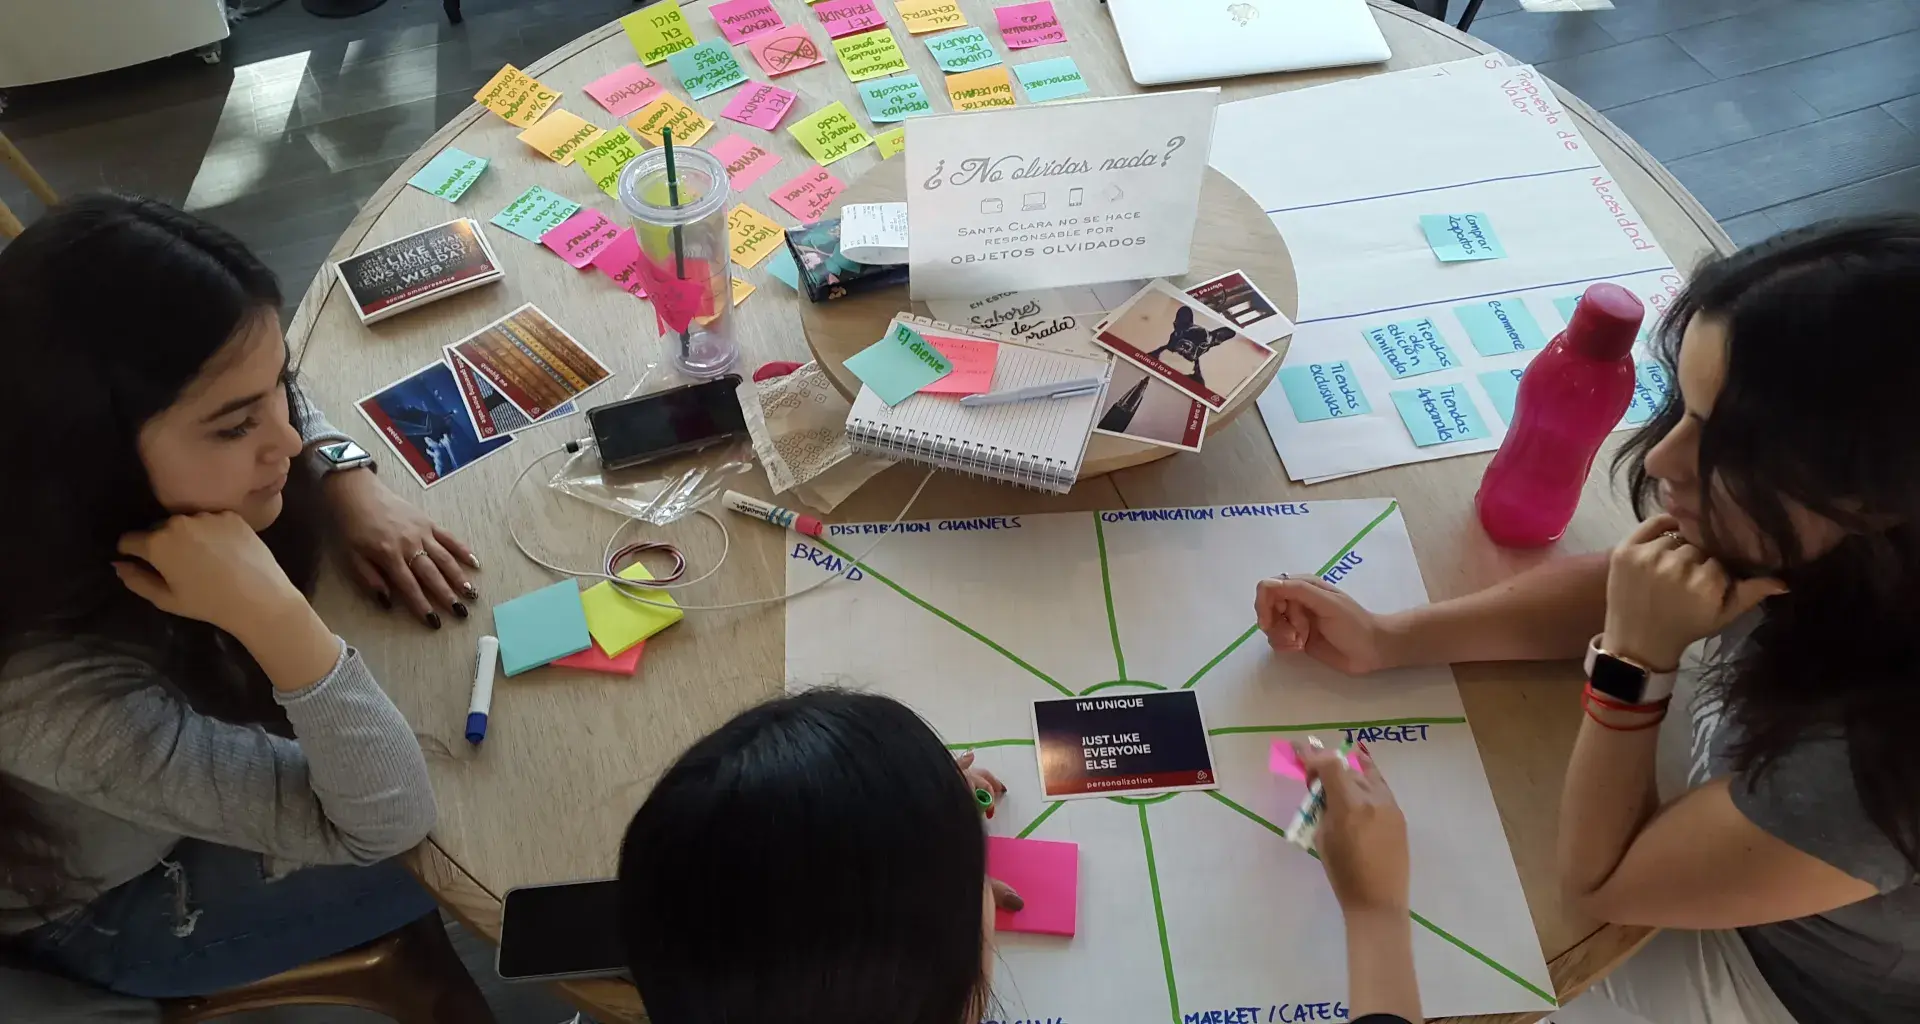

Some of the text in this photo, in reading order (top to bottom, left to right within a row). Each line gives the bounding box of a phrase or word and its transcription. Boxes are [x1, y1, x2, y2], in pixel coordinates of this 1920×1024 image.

[650, 11, 680, 28] BICI
[902, 4, 956, 21] CENTERS
[928, 14, 960, 25] CALL
[737, 18, 778, 35] TIENDA
[847, 16, 872, 29] PET
[661, 28, 682, 41] EN
[932, 34, 984, 51] PLANETA
[694, 47, 714, 60] USO
[840, 37, 874, 58] general
[847, 45, 895, 62] animales
[956, 44, 980, 53] DEL
[696, 52, 729, 70] DOBLE
[948, 50, 993, 67] CUIDADO
[605, 78, 656, 106] PREMIOS
[1500, 80, 1534, 117] Valor
[882, 100, 929, 118] PREMIOS
[890, 96, 904, 106] tu
[962, 96, 1016, 110] PRODUCTOS
[1516, 68, 1580, 151] Propuesta de
[676, 118, 705, 140] Agua
[818, 114, 846, 128] todo
[850, 133, 866, 146] La
[611, 146, 636, 166] PET
[1012, 155, 1092, 182] olvidas
[1100, 135, 1186, 172] nada?
[1590, 176, 1656, 251] Necesidad
[738, 224, 756, 238] en
[958, 212, 1142, 238] SANTA CLARA NO SE HACE
[1465, 214, 1492, 252] Comprar
[733, 226, 780, 255] Tienda
[985, 226, 1115, 246] RESPONSABLE POR
[386, 245, 428, 266] LIKE
[950, 236, 1148, 265] OBJETOS OLVIDADOS
[401, 264, 443, 283] WEB
[970, 300, 984, 310] EN
[1011, 320, 1046, 336] de
[1409, 334, 1426, 350] de
[1416, 318, 1452, 368] Tiendas
[1370, 328, 1407, 375] limitada
[1134, 352, 1172, 376] animal love
[1310, 364, 1343, 418] exclusivas
[1331, 362, 1360, 410] Tiendas
[1440, 386, 1470, 435] Tiendas
[1102, 503, 1310, 524] COMMUNICATION CHANNELS
[938, 516, 1022, 531] CHANNELS
[791, 542, 864, 582] BRAND
[1076, 698, 1144, 712] I'M UNIQUE
[1082, 732, 1140, 746] JUST LIKE
[1338, 724, 1430, 744] TARGET
[1084, 744, 1152, 758] EVERYONE
[1086, 758, 1118, 770] ELSE
[1086, 776, 1154, 788] personalization
[1184, 1007, 1261, 1024] MARKET
